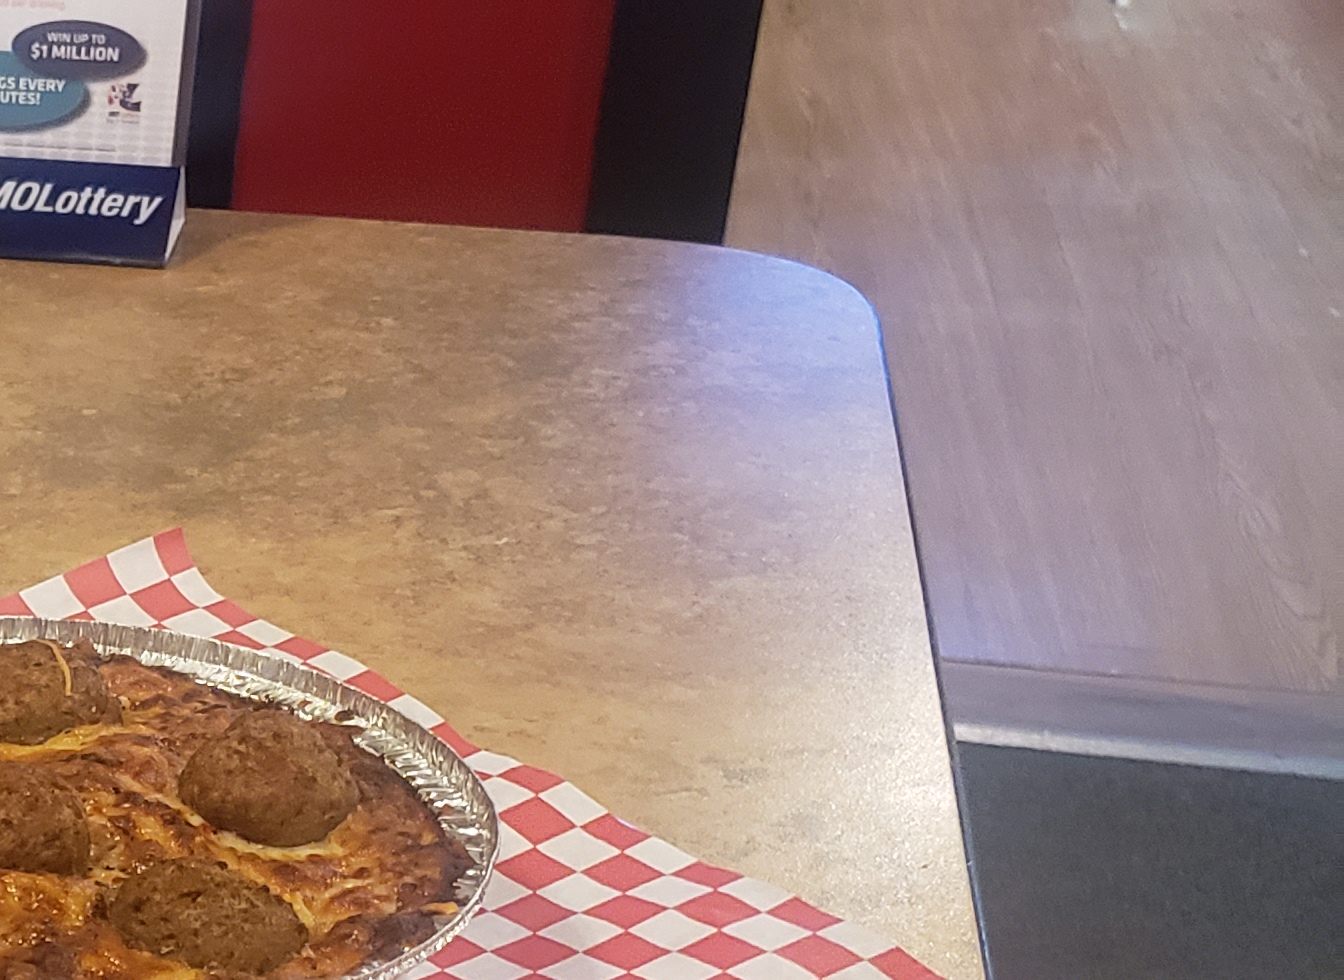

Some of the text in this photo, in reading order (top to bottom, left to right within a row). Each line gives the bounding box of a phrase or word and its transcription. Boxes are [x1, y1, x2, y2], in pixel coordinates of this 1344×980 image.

[47, 31, 106, 45] WIN UP TO
[31, 44, 119, 62] $1 MILLION
[19, 77, 66, 93] EVERY
